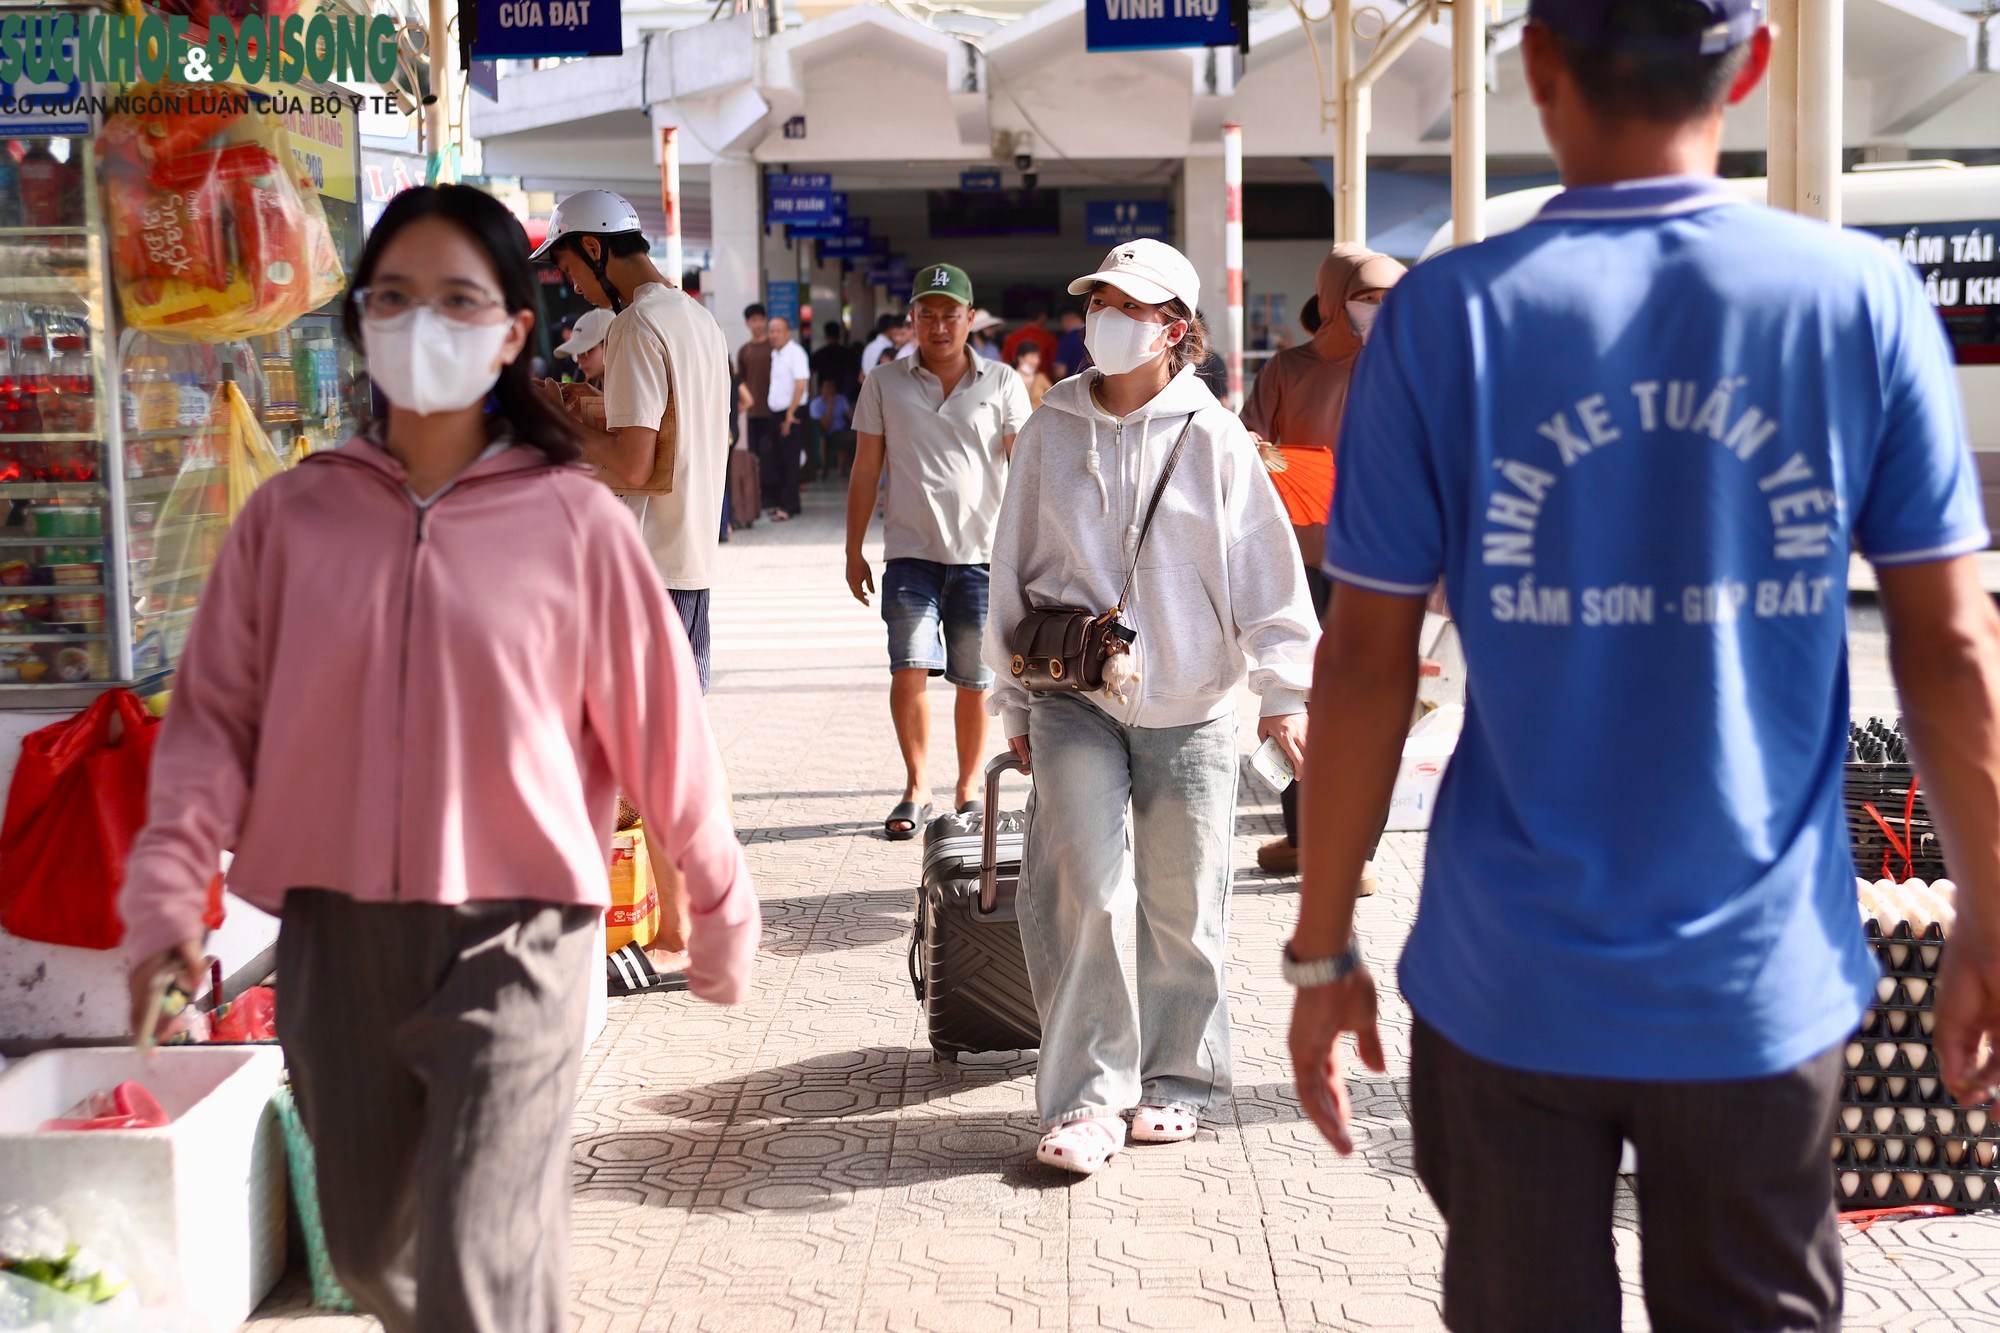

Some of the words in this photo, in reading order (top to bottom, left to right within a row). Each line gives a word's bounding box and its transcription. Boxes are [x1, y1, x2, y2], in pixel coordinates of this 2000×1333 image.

[549, 2, 590, 31] ĐẠT
[365, 157, 426, 201] LÂ
[1482, 457, 1557, 566] NHÀ
[1537, 393, 1622, 467] XE
[1581, 582, 1655, 627] SƠN
[1755, 570, 1834, 618] BÁT
